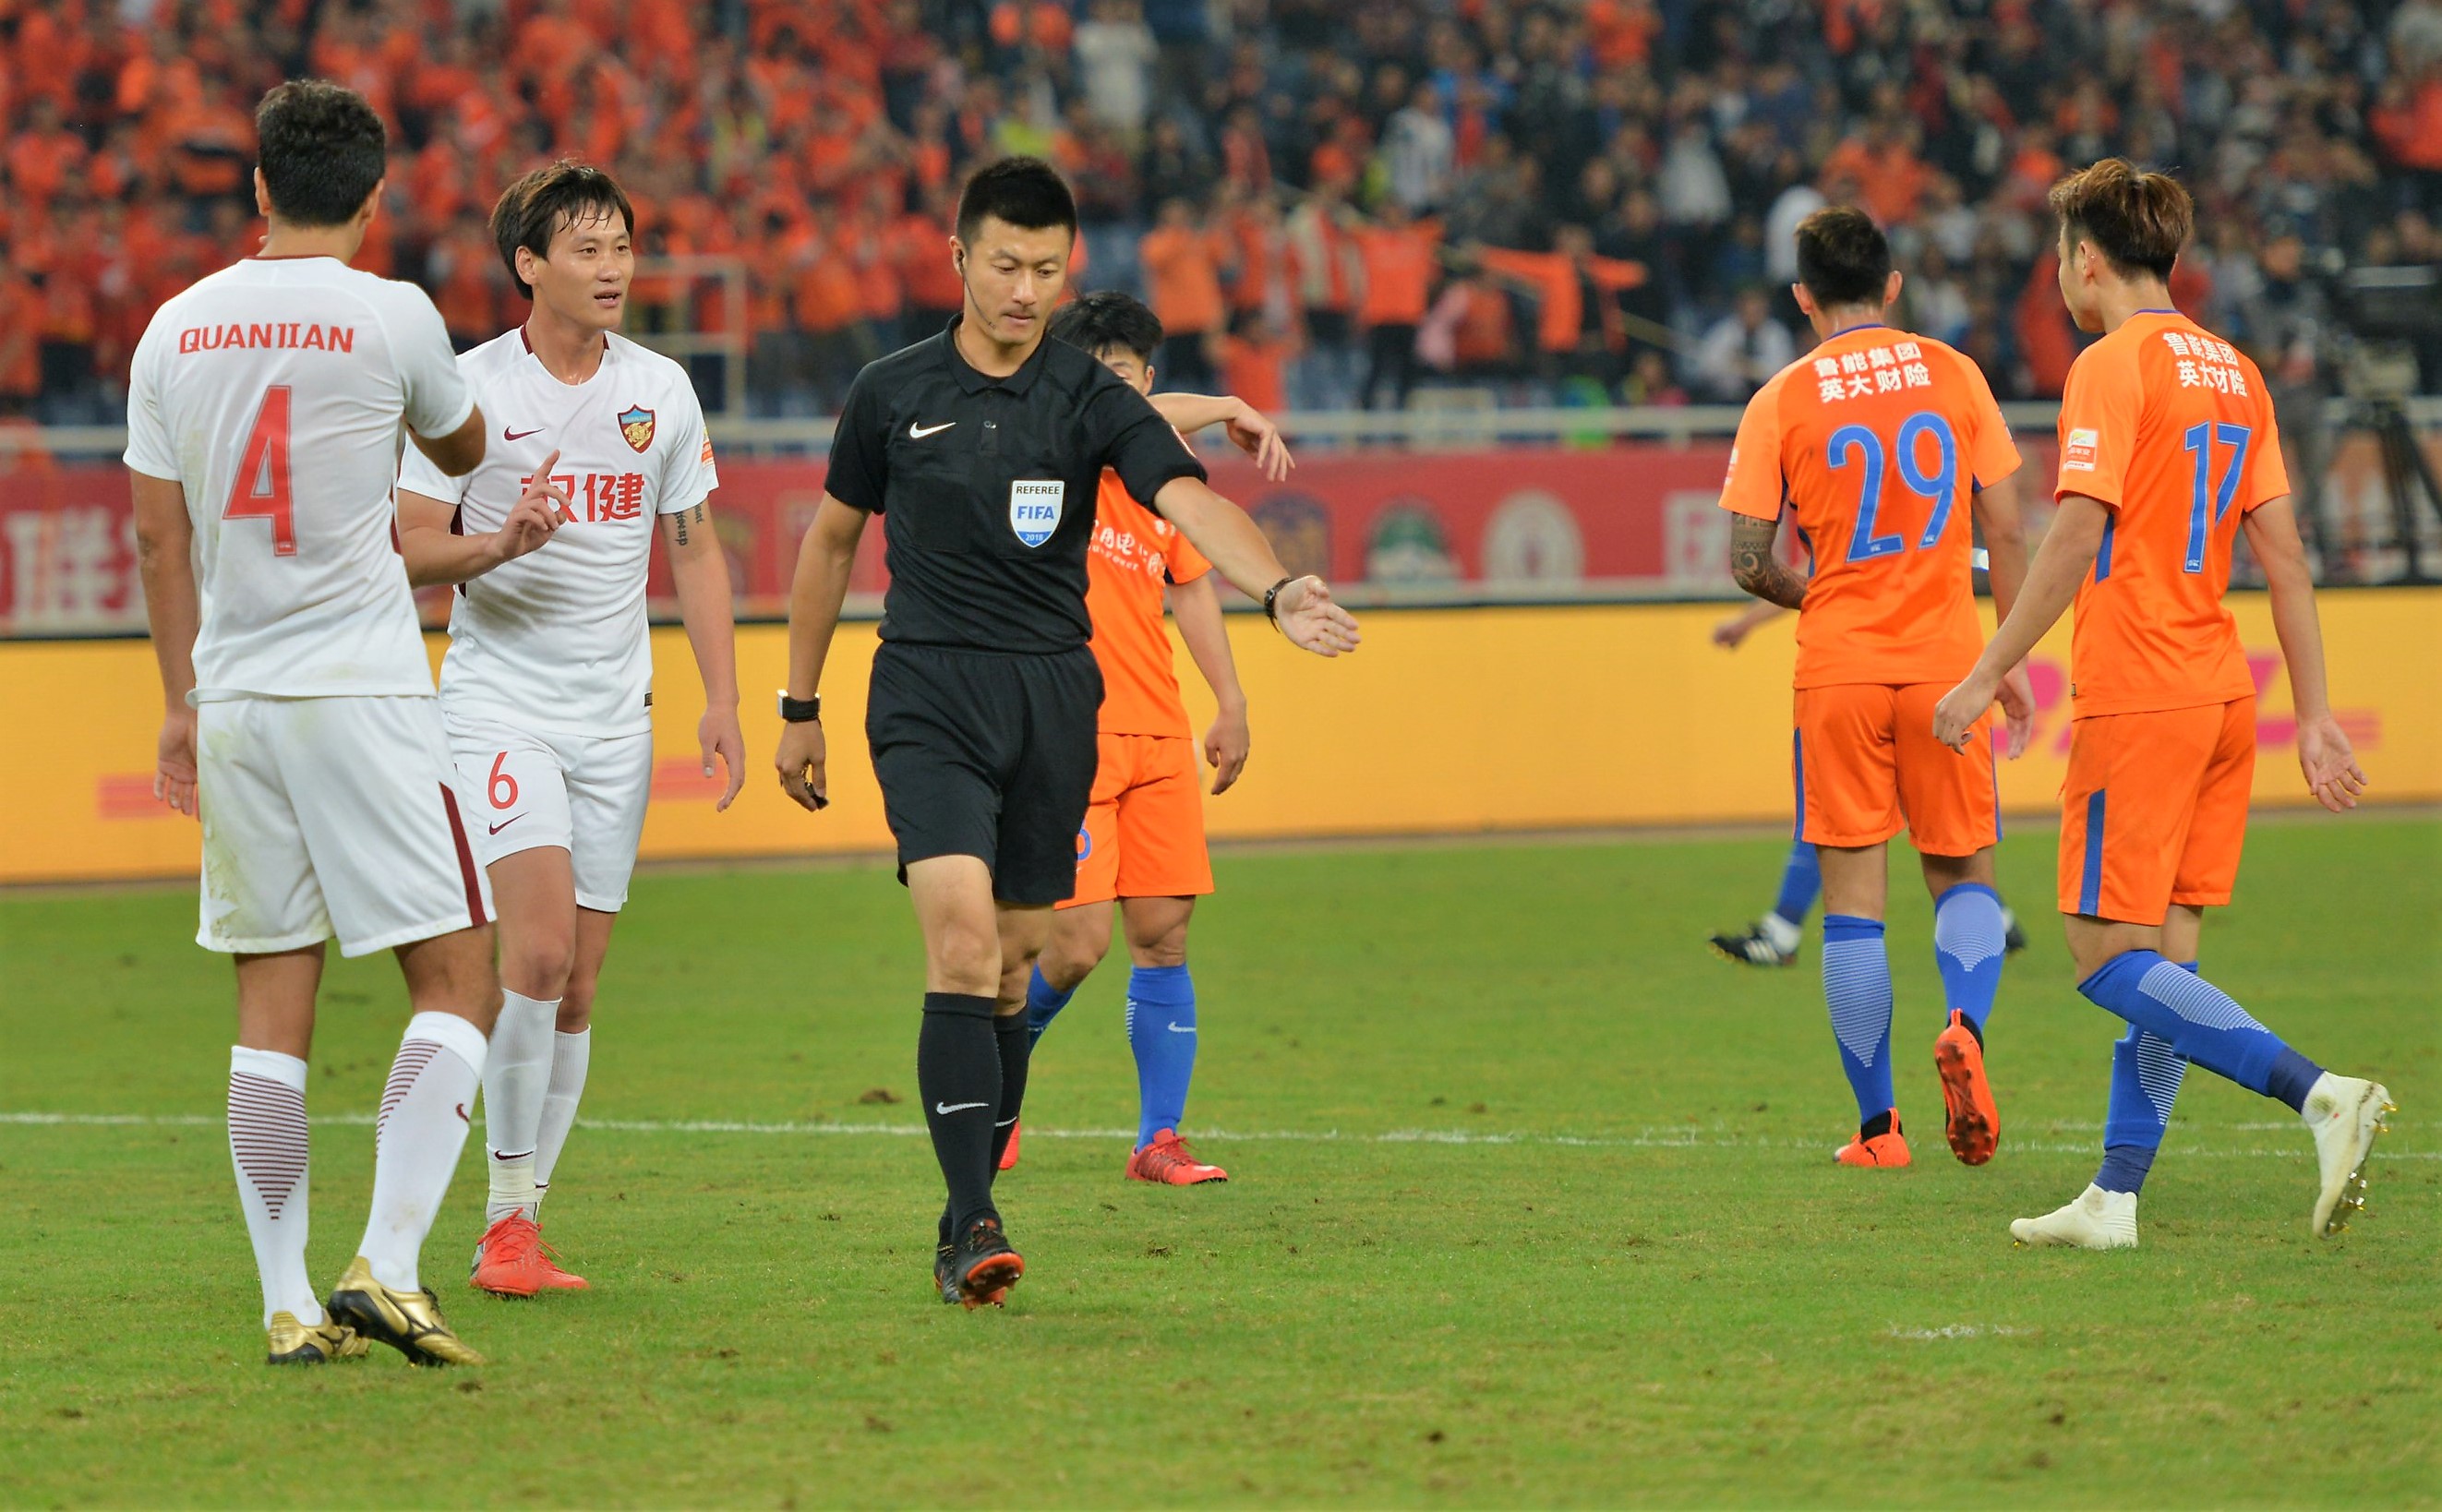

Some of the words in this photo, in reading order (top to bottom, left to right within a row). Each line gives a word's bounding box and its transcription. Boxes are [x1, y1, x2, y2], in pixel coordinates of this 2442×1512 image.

[1813, 342, 1922, 378] 鲁能集团
[2162, 331, 2240, 367] 鲁能集团
[1818, 363, 1931, 403] 英大财险
[222, 385, 297, 557] 4
[1827, 412, 1956, 562] 29
[1016, 486, 1060, 495] REFEREE
[2183, 420, 2252, 573] 17
[1016, 505, 1054, 519] FIFA
[1026, 533, 1044, 542] 2018
[487, 750, 519, 810] 6
